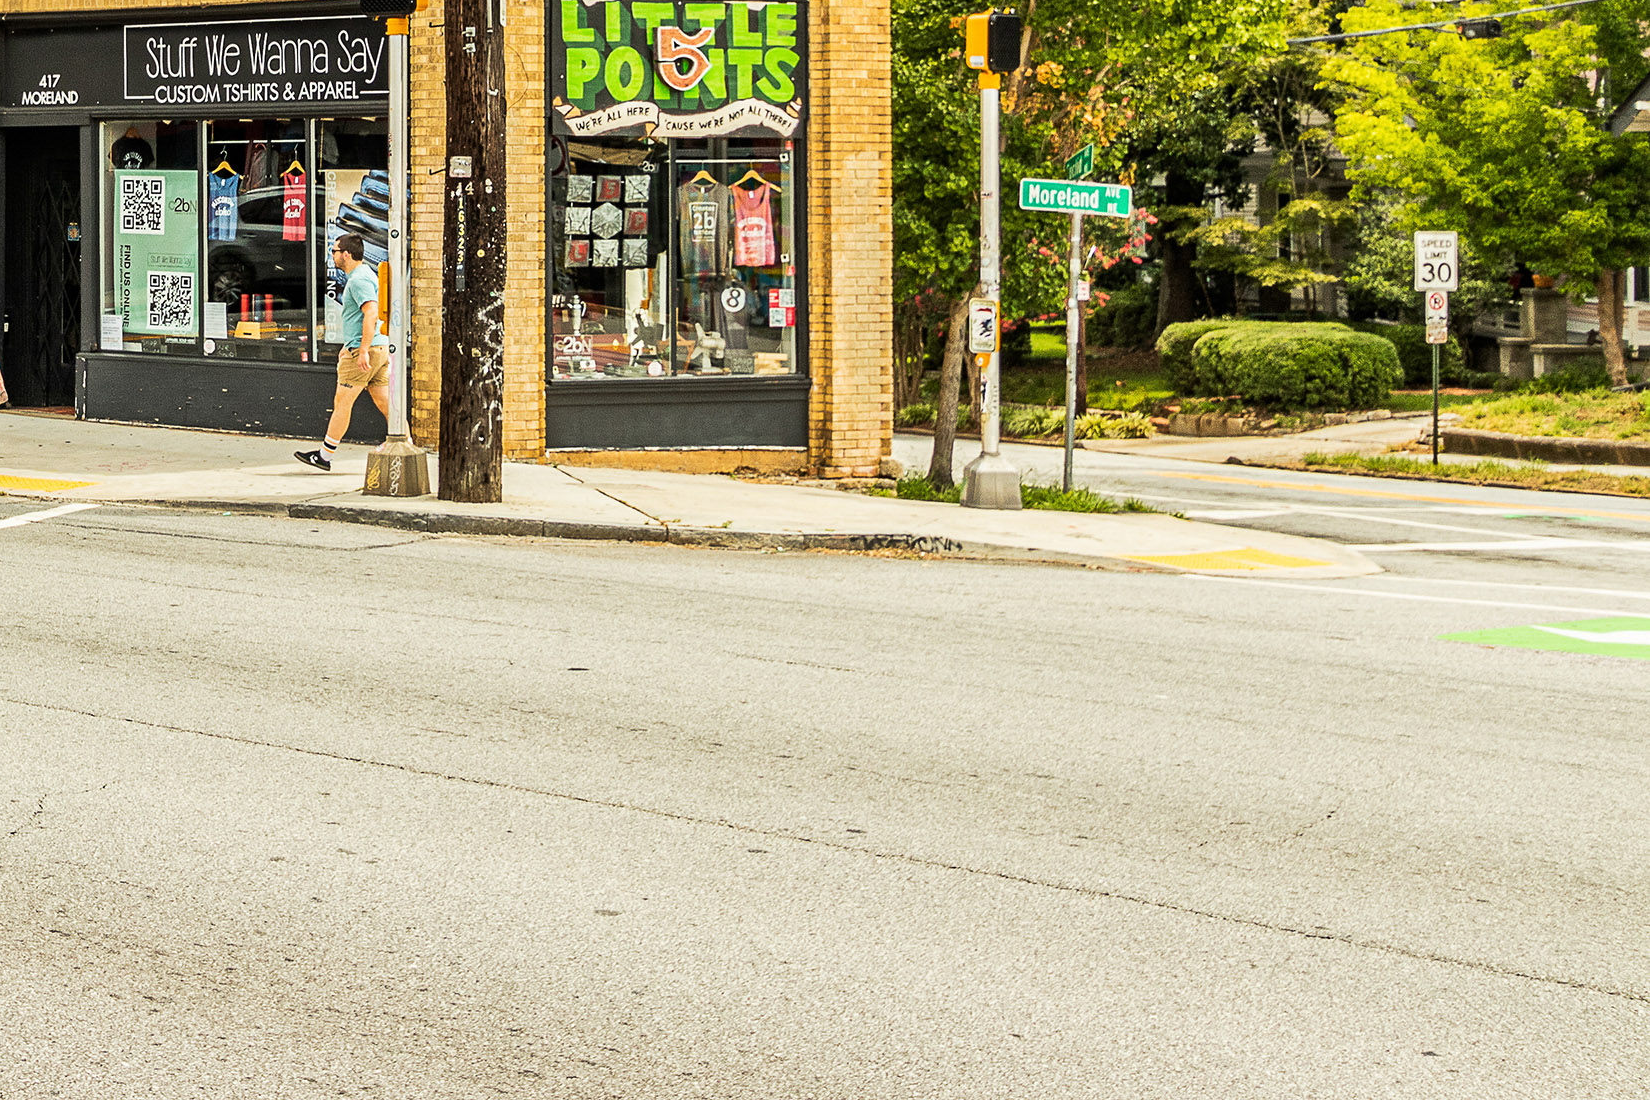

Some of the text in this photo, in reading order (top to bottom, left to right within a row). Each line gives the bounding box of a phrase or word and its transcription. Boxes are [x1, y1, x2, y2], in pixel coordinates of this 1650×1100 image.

[560, 0, 798, 47] LITTLE
[146, 29, 386, 84] Stuff We Wanna Say
[655, 25, 715, 91] 5
[38, 74, 61, 88] 417
[154, 80, 360, 104] CUSTOM TSHIRTS & APPAREL
[21, 90, 79, 105] MORELAND
[575, 107, 650, 131] WE'RE ALL HERE
[665, 105, 792, 131] 'CAUSE WE'RE NOT ALL THERE!
[326, 171, 337, 233] CREATED
[1028, 183, 1121, 209] Moreland AVE
[1106, 202, 1118, 214] NE
[457, 197, 465, 263] 16323
[693, 211, 714, 230] 2b
[1421, 239, 1452, 249] SPEED
[1424, 251, 1448, 260] LIMIT
[326, 259, 337, 277] BE
[1422, 262, 1452, 283] 30
[122, 244, 131, 328] FIND US ONLINE
[726, 289, 741, 308] 8
